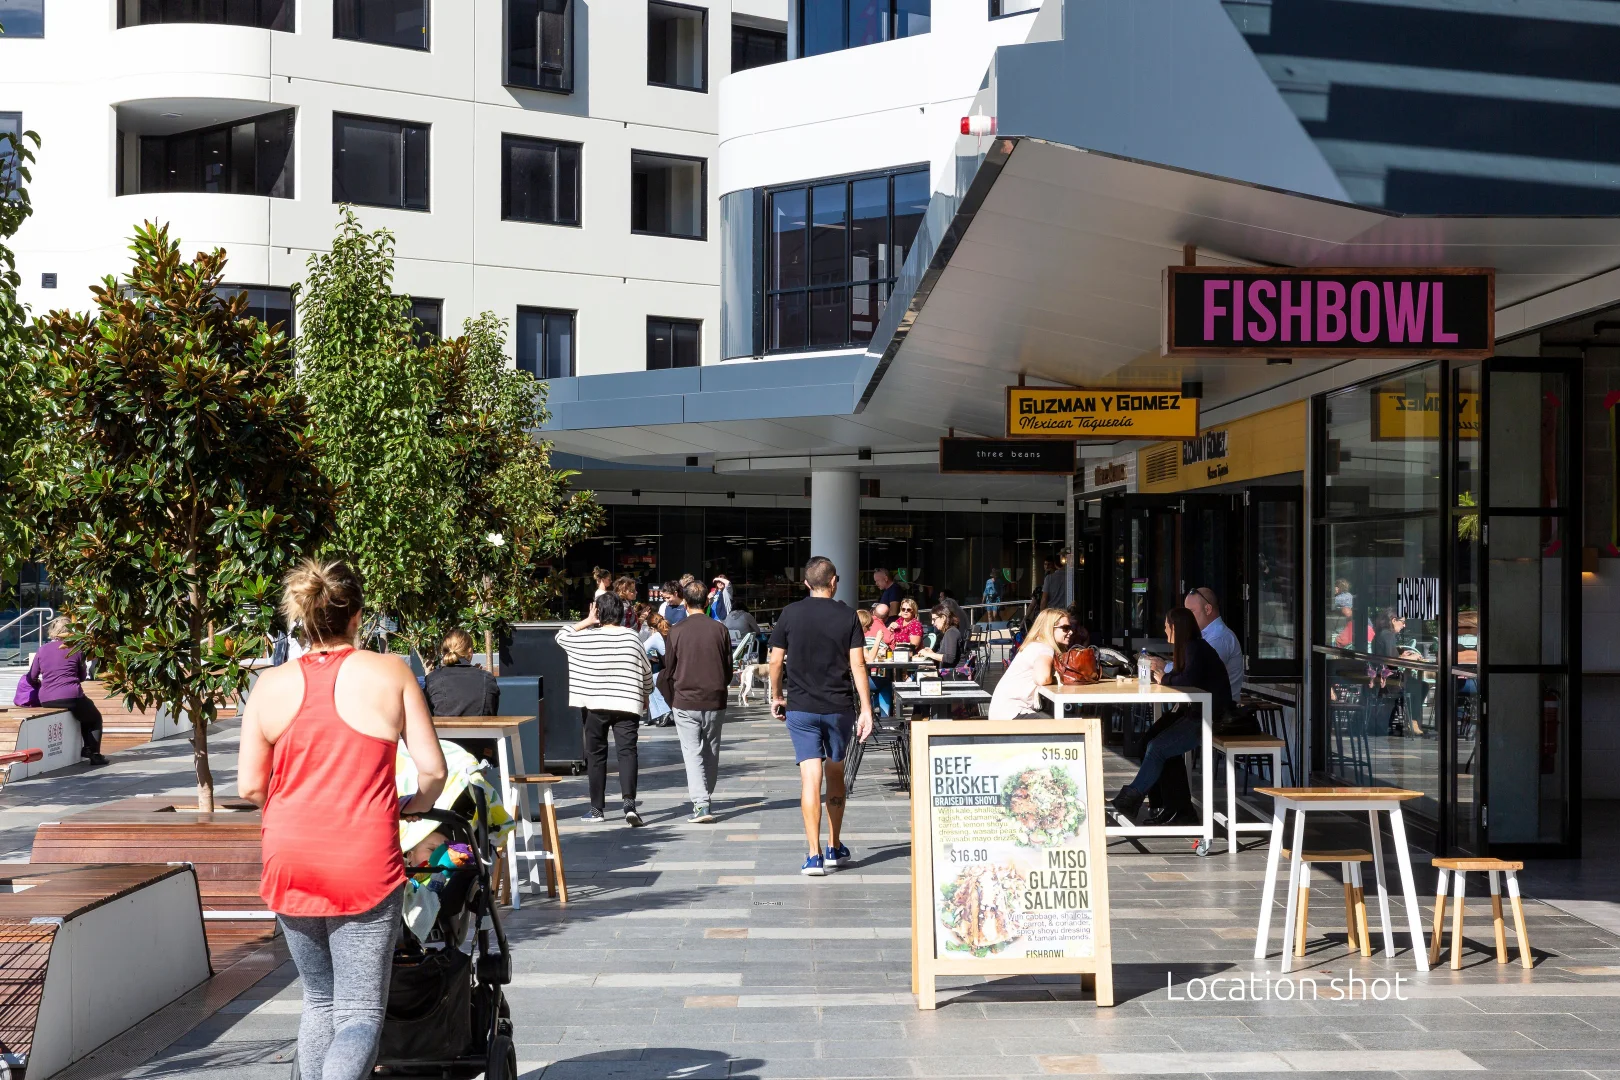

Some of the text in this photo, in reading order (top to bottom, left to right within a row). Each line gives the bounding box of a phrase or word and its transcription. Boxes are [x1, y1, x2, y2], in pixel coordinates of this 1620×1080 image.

[1203, 279, 1459, 344] FISHBOWL
[1019, 394, 1180, 414] GUZMAN Y GOMEZ
[1019, 416, 1073, 429] Mexican
[1397, 577, 1439, 620] FISHBOWL
[1041, 747, 1078, 761] $15.90
[934, 756, 972, 775] BEEF
[935, 775, 999, 795] BRISKET
[934, 795, 998, 806] BRAISED IN SHOYU
[950, 849, 988, 862] $16.90
[1048, 850, 1087, 869] MISO
[1029, 870, 1088, 889] GLAZED
[1024, 890, 1089, 910] SALMON
[1016, 926, 1091, 936] spicy shoyu dressing
